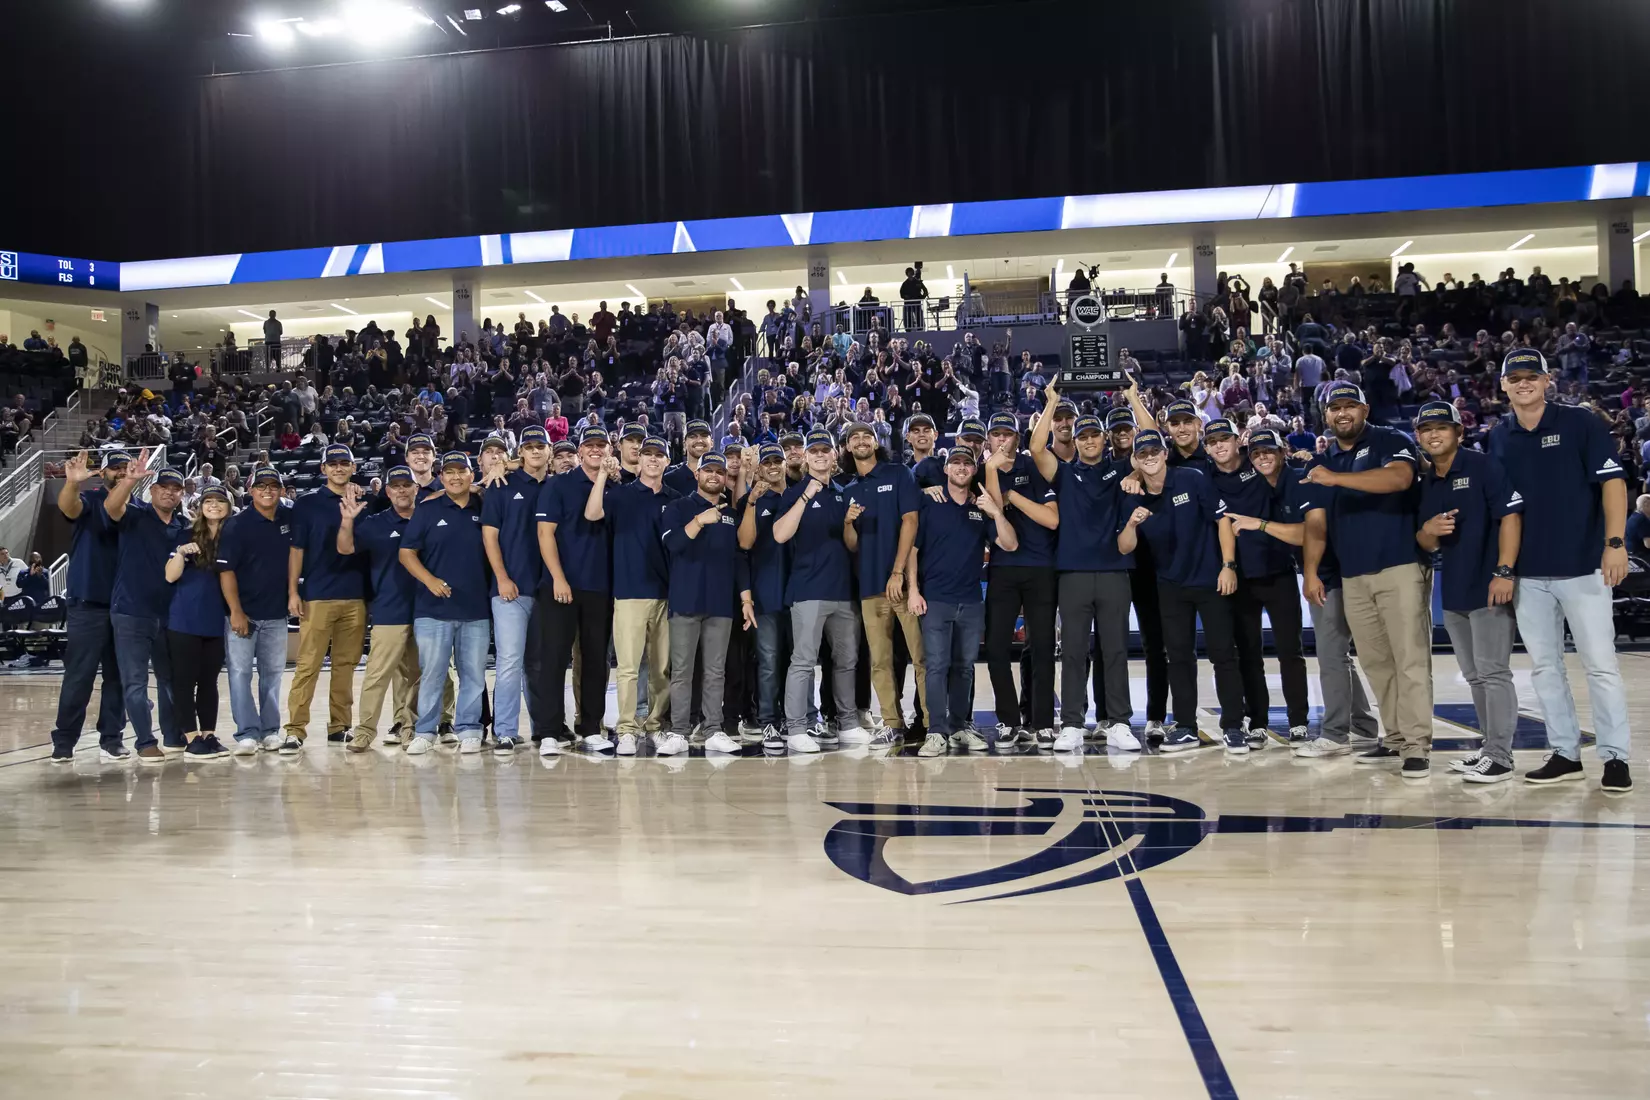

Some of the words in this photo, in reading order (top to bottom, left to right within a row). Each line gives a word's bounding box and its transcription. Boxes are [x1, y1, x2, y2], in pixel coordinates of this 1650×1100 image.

[58, 260, 74, 270] TOL
[89, 262, 95, 272] 3
[58, 273, 73, 282] FLS
[89, 275, 95, 285] 0
[1076, 306, 1100, 316] WAC
[1542, 434, 1561, 444] CBU
[1102, 470, 1117, 481] CBU
[1452, 477, 1470, 487] CBU
[877, 484, 893, 493] CBU
[1172, 492, 1189, 504] CBU
